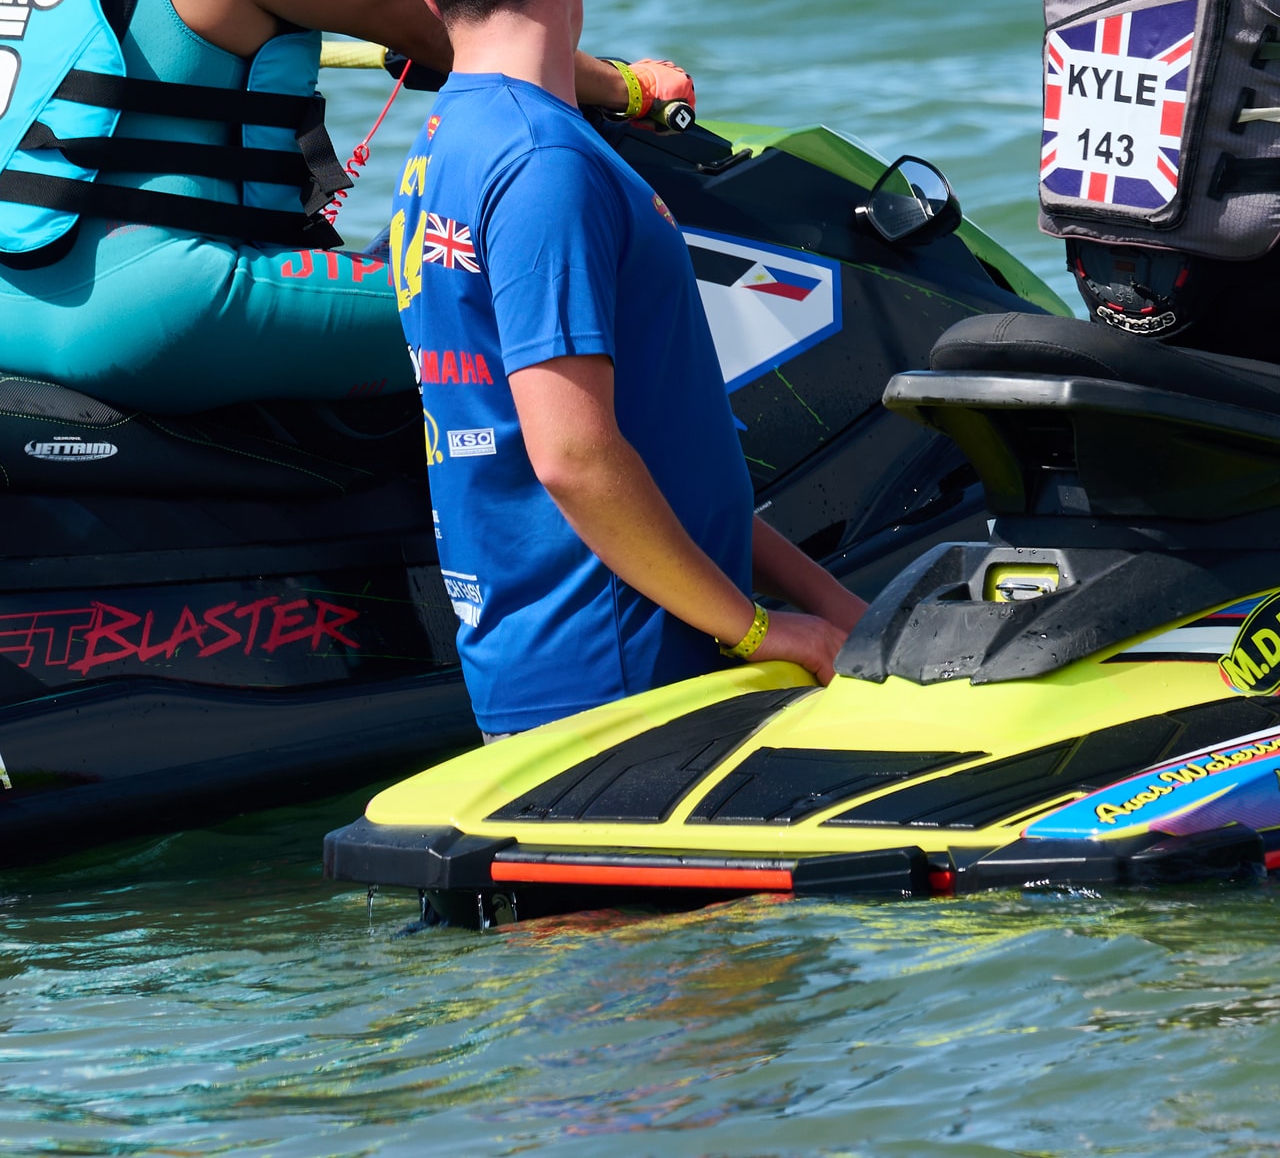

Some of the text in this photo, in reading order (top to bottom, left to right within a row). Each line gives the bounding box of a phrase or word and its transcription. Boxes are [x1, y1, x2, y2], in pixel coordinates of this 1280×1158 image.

[1068, 64, 1158, 107] KYLE
[1077, 127, 1135, 168] 143
[281, 249, 393, 287] JTP
[422, 350, 494, 385] MAHA
[28, 442, 112, 456] JETTRIM
[452, 432, 491, 447] KSO
[1094, 782, 1171, 826] Avos
